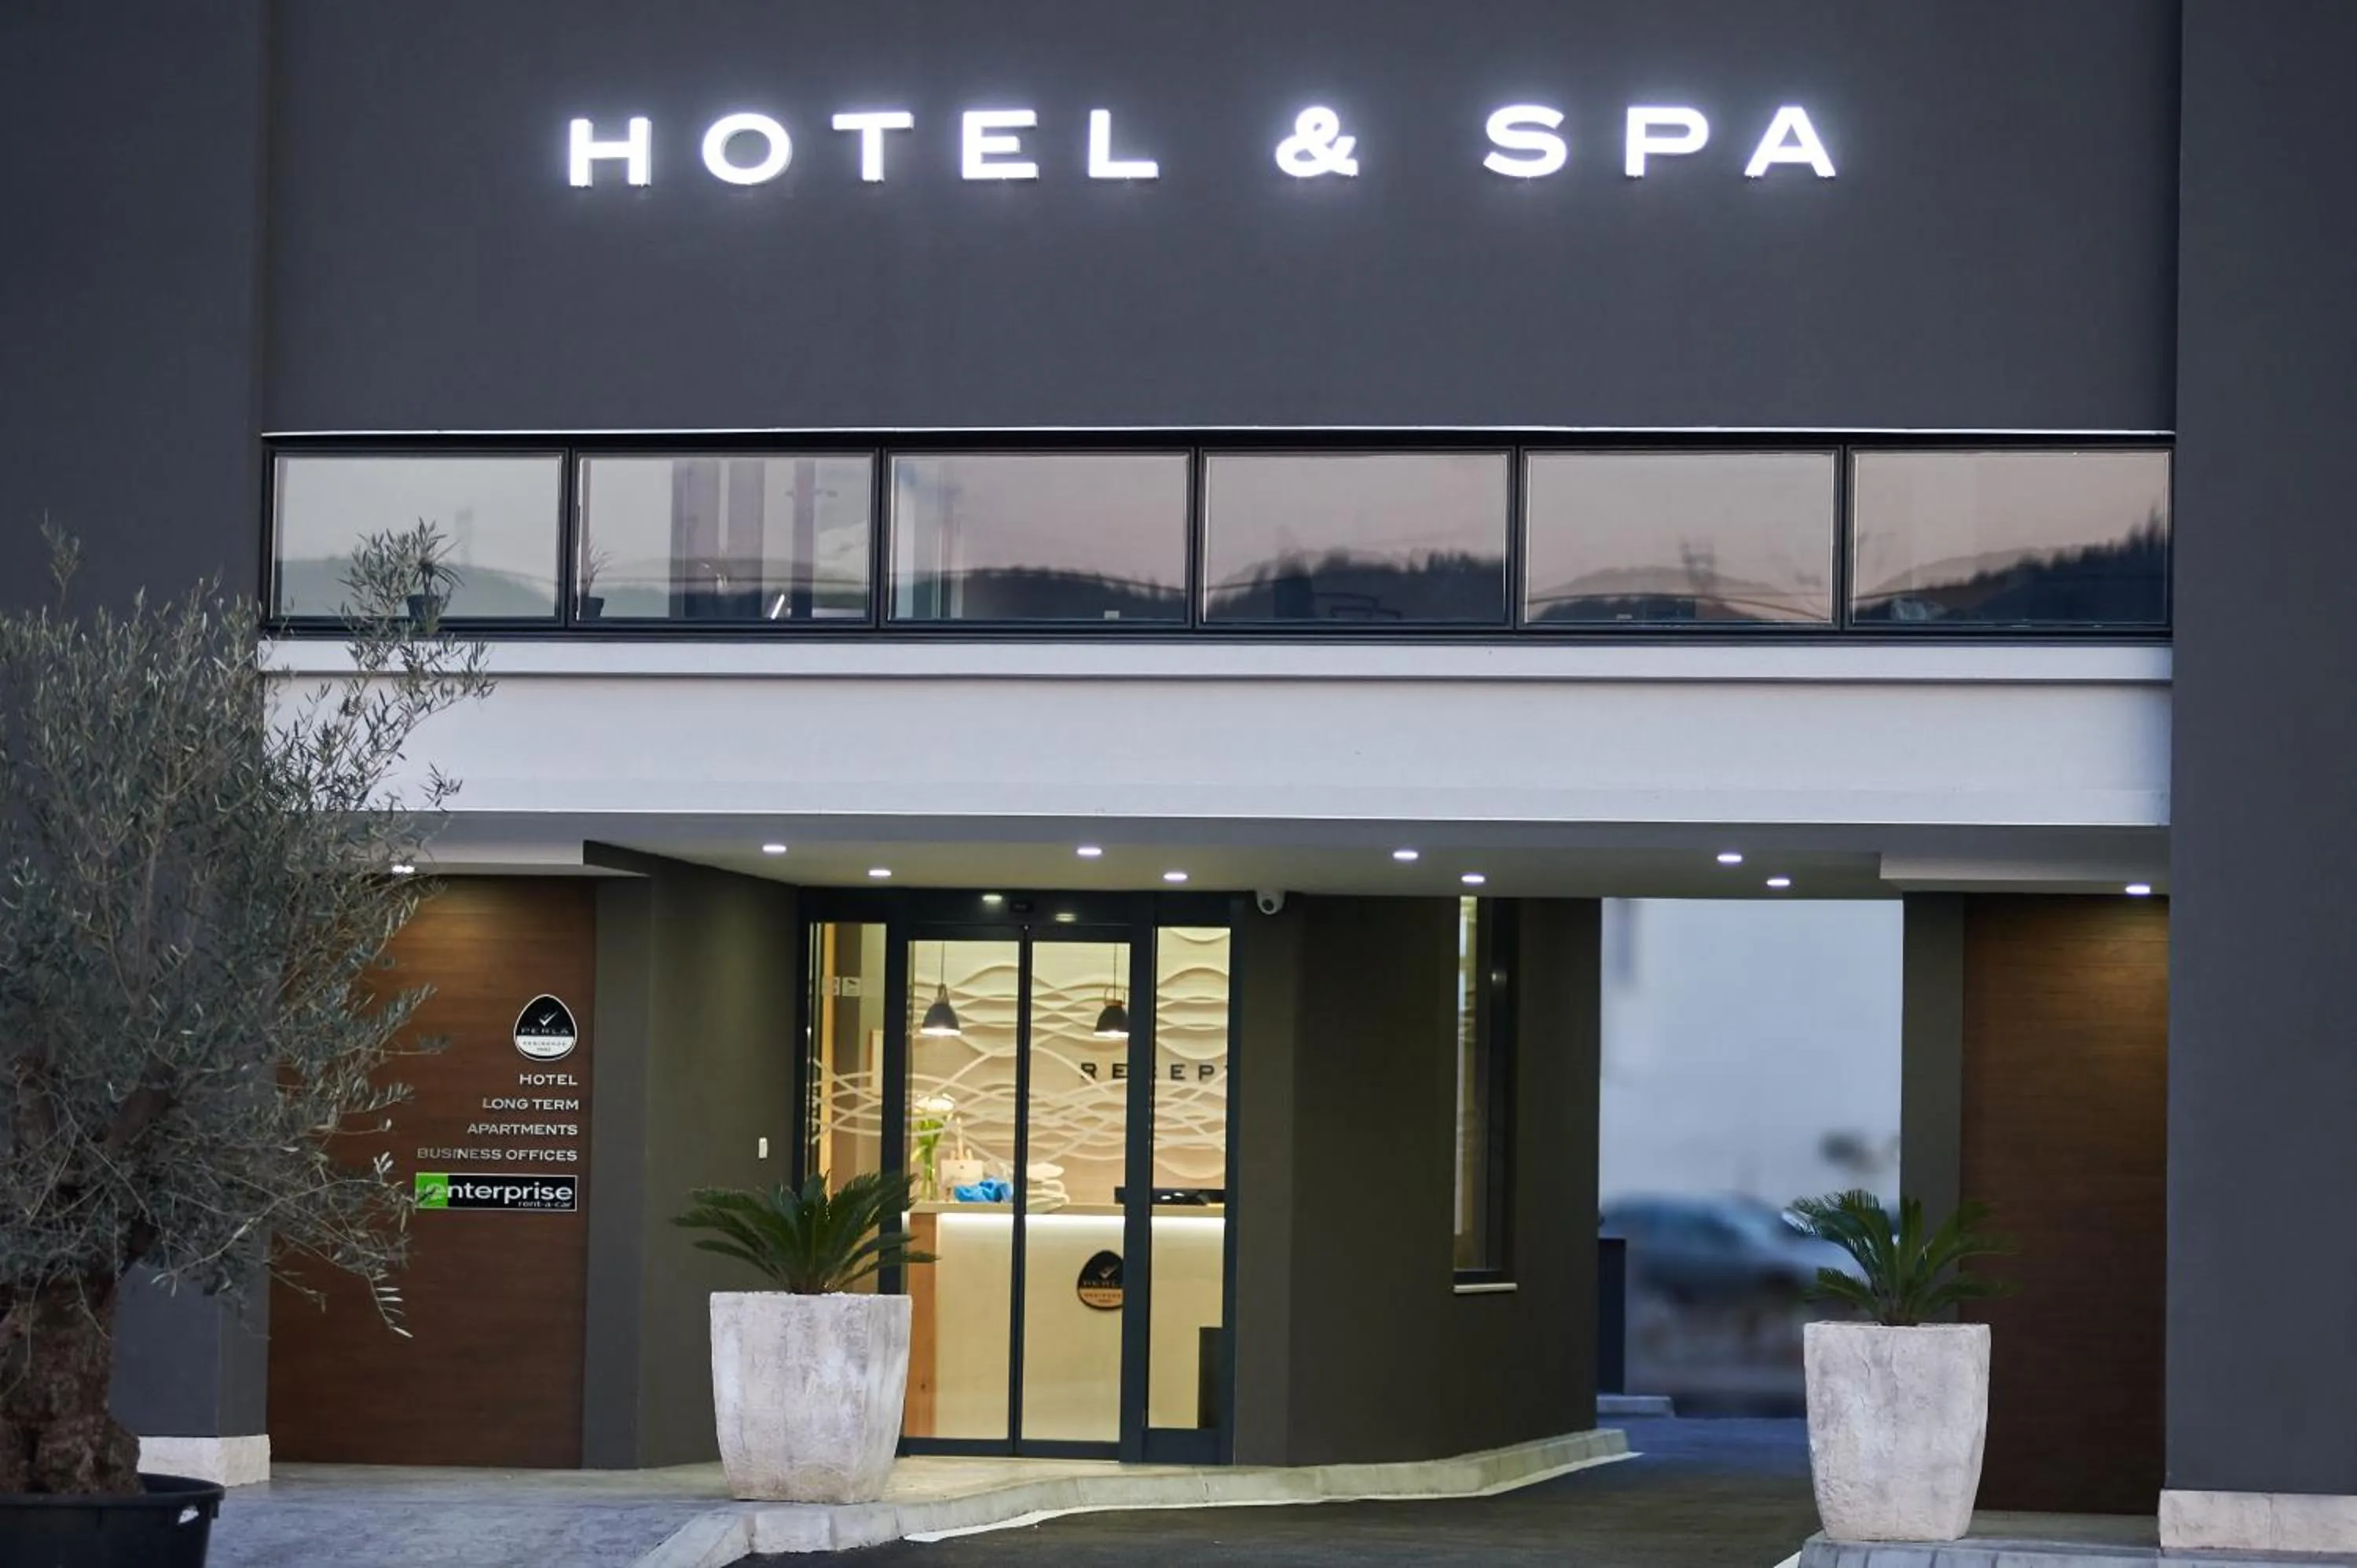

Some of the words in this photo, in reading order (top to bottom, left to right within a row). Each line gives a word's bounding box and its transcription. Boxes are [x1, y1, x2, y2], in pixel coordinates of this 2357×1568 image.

[570, 110, 1158, 187] HOTEL
[1276, 106, 1358, 177] &
[1483, 104, 1835, 178] SPA
[1080, 1063, 1227, 1081] REEP
[519, 1074, 578, 1085] HOTEL
[482, 1098, 529, 1110] LONG
[533, 1100, 579, 1111] TERM
[467, 1124, 578, 1135] APARTMENTS
[417, 1148, 502, 1160] BUSINESS
[505, 1149, 577, 1161] OFFICES
[419, 1182, 573, 1204] enterprise
